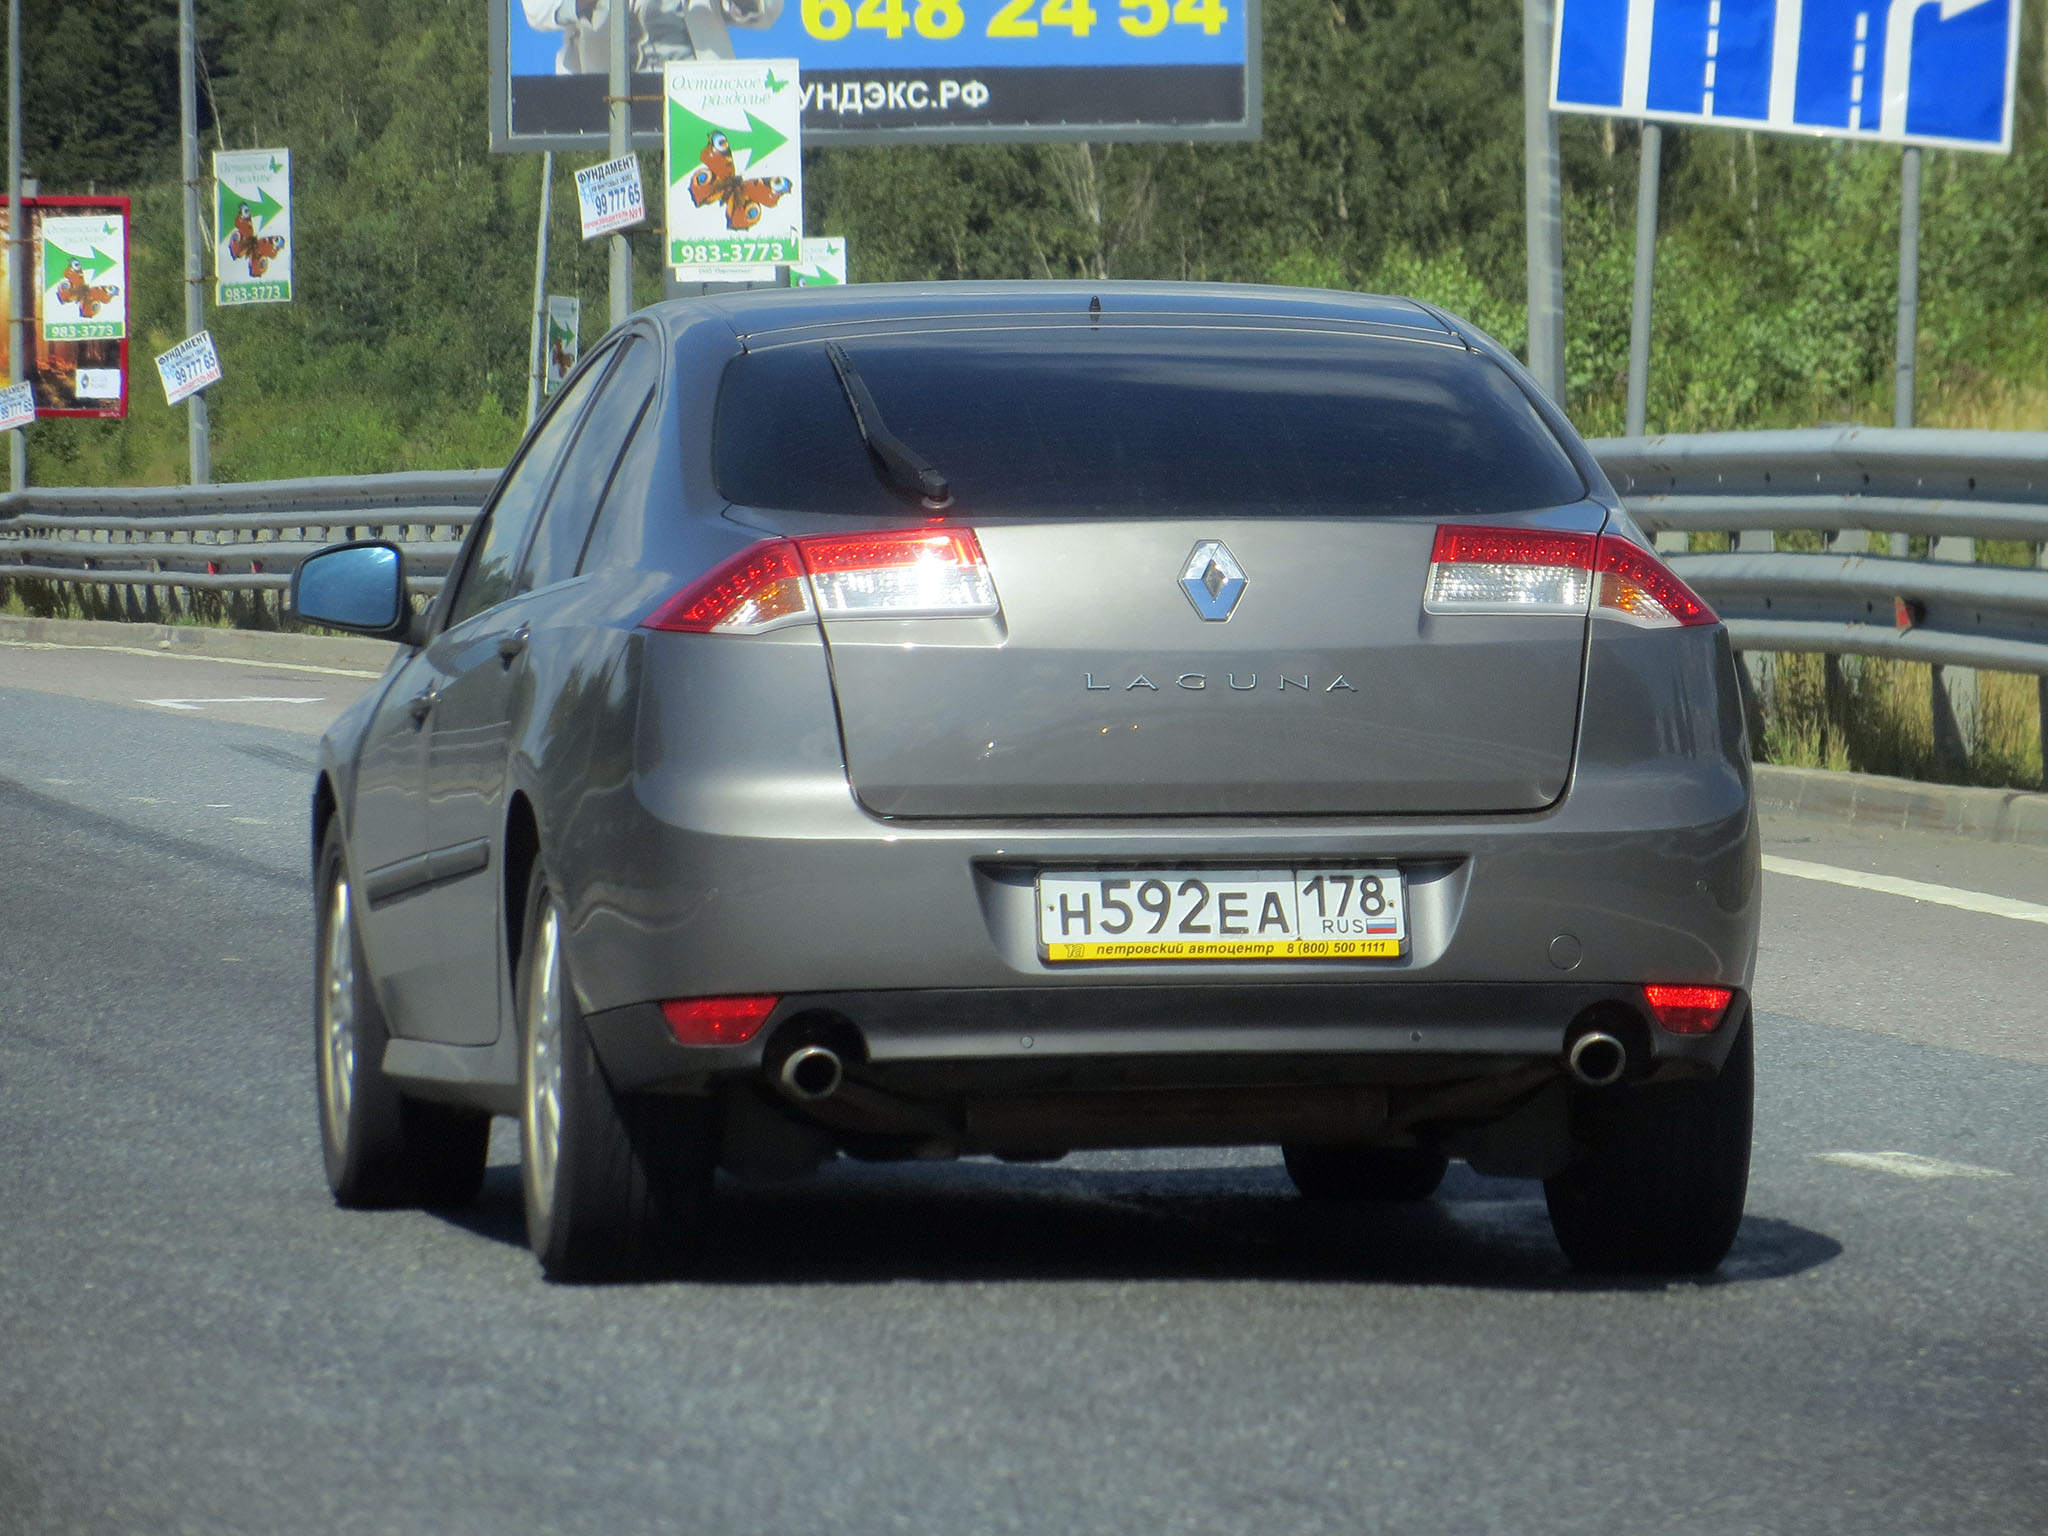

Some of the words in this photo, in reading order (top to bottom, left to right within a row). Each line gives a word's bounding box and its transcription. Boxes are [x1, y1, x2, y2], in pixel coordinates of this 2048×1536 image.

[802, 0, 965, 40] 648
[986, 0, 1097, 37] 24
[1119, 0, 1228, 36] 54
[577, 156, 635, 183] ФУНДАМЕНТ
[595, 193, 608, 217] 99
[608, 186, 627, 213] 777
[628, 182, 641, 205] 65
[680, 243, 784, 262] 983-3773
[225, 285, 280, 301] 983-3773
[51, 325, 114, 338] 983-3773
[1083, 672, 1359, 692] LAGUNA
[1302, 875, 1387, 917] 178
[1322, 919, 1365, 934] RUS
[1096, 943, 1183, 957] петровский
[1188, 943, 1274, 956] автоцентр
[1286, 943, 1294, 954] 8
[1298, 941, 1329, 955] (800)
[1334, 942, 1355, 953] 500
[1360, 942, 1386, 952] 1111
